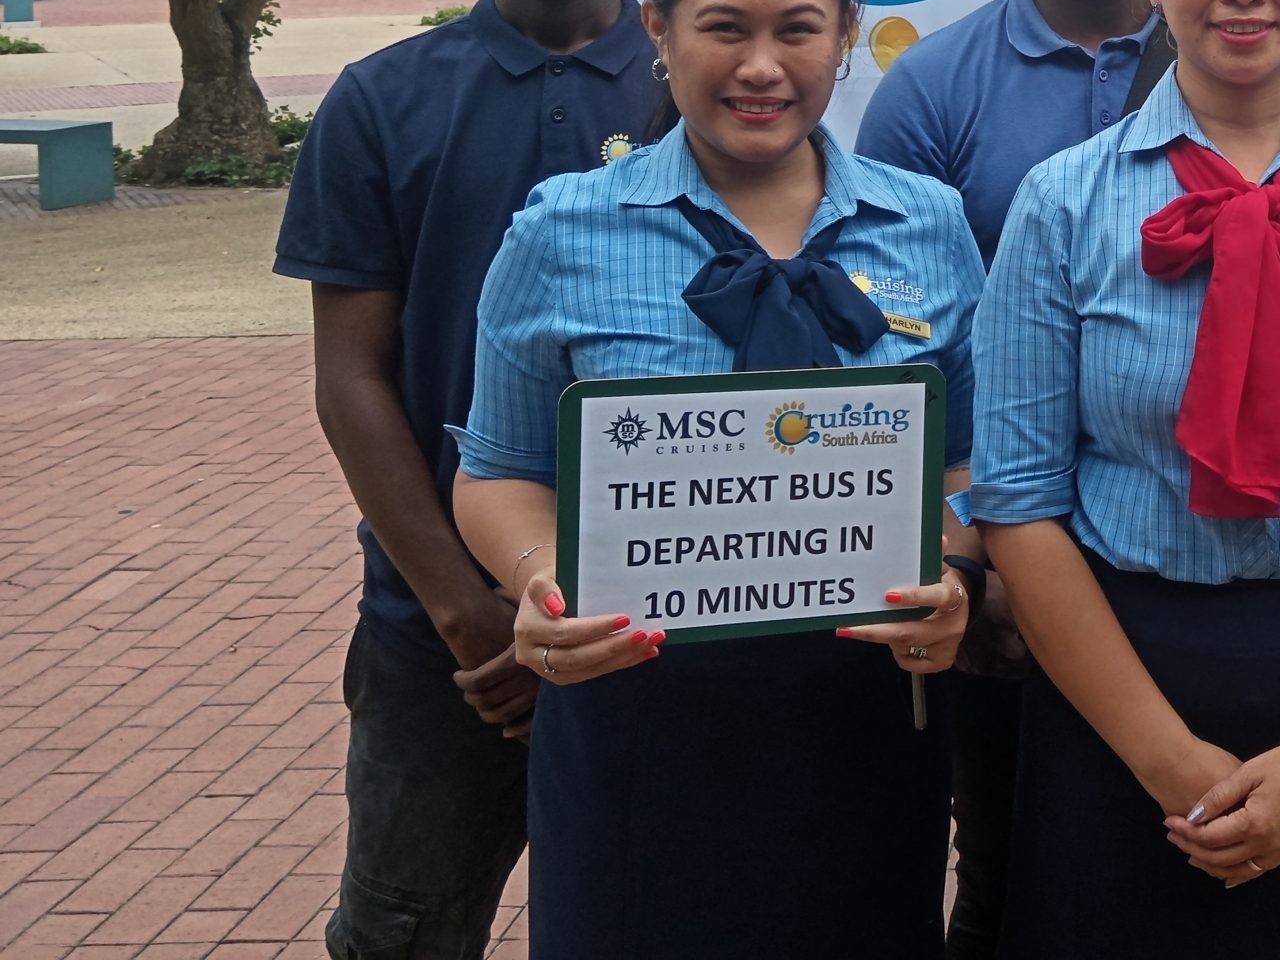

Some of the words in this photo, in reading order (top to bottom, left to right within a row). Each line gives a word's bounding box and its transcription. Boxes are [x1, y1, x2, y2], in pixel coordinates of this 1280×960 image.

[885, 316, 921, 332] HARLYN
[656, 409, 746, 440] MSC
[774, 402, 911, 446] Cruising
[822, 431, 859, 448] South
[860, 430, 898, 446] Africa
[656, 442, 745, 455] CRUISES
[608, 480, 677, 511] THE
[688, 474, 779, 506] NEXT
[789, 470, 855, 501] BUS
[866, 468, 894, 496] IS
[626, 527, 827, 567] DEPARTING
[840, 525, 874, 552] IN
[644, 589, 686, 619] 10
[697, 577, 856, 615] MINUTES
